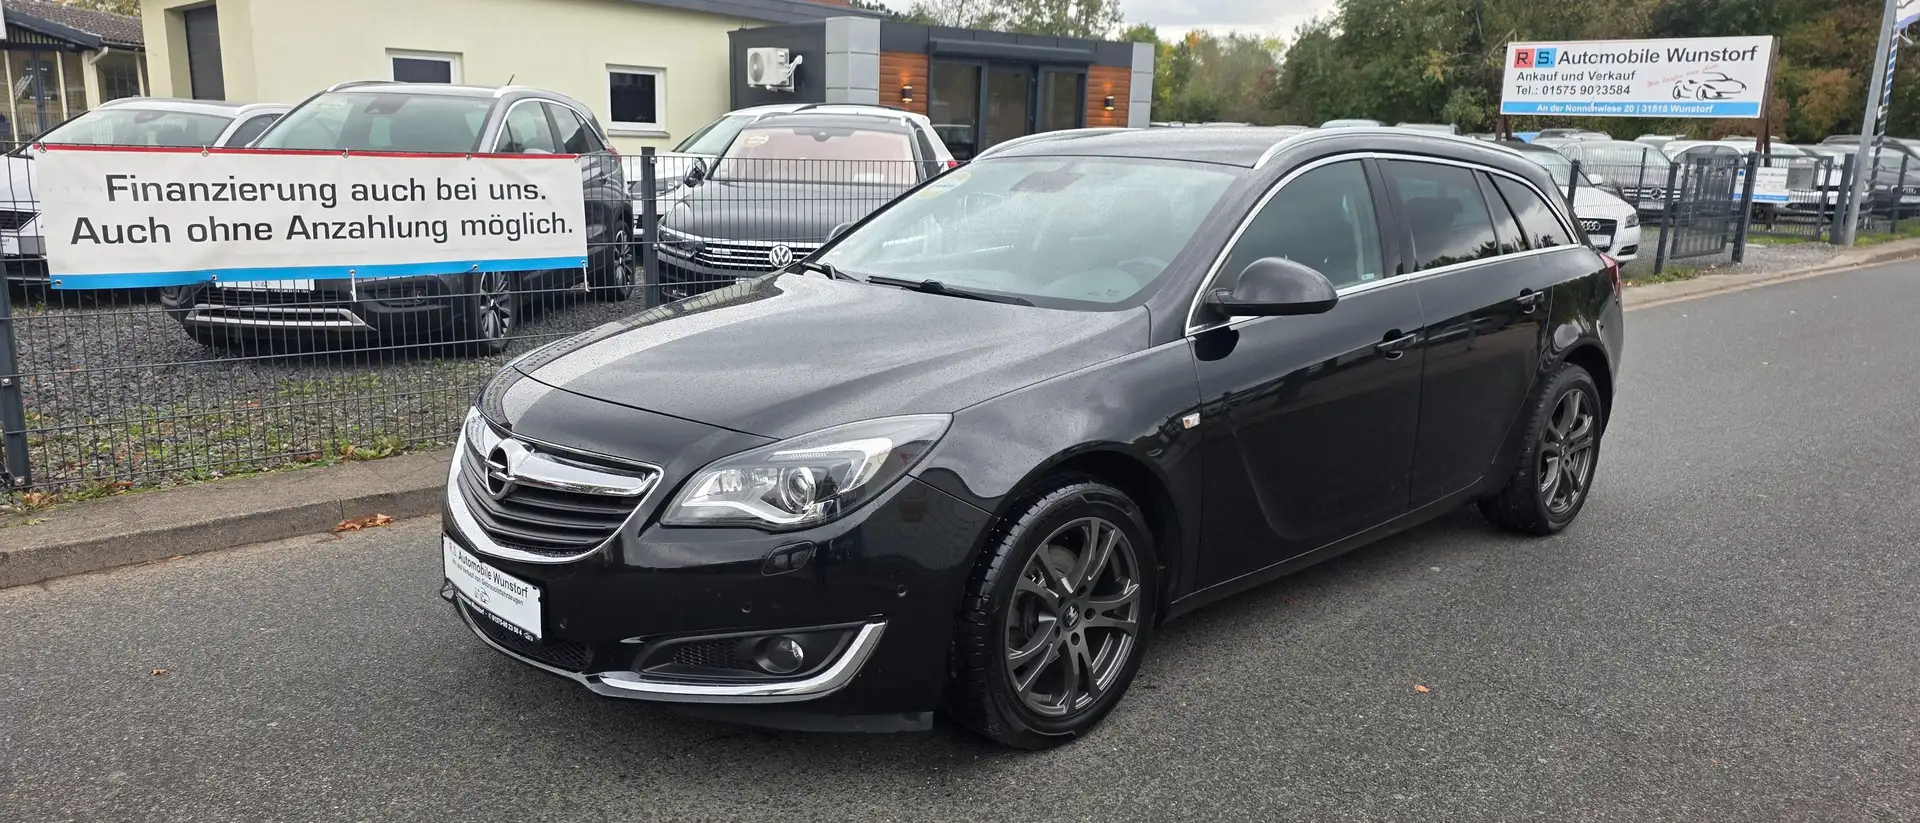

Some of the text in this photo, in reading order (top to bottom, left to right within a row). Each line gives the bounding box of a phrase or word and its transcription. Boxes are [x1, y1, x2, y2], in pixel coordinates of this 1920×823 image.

[1516, 45, 1759, 65] R. S. Automobile Wunstorf
[1516, 70, 1637, 82] Ankauf und Verkauf
[1516, 85, 1539, 96] Tel.:
[1542, 85, 1577, 96] 01575
[1536, 104, 1548, 112] An
[1550, 104, 1563, 112] der
[1624, 104, 1635, 113] 20
[1671, 104, 1714, 113] Wunstorf
[105, 174, 547, 208] Finanzierung auch bei uns.
[70, 212, 573, 245] Auch ohne Anzahlung möglich.
[459, 551, 492, 581] Automobile
[493, 571, 529, 599] Wunstorf
